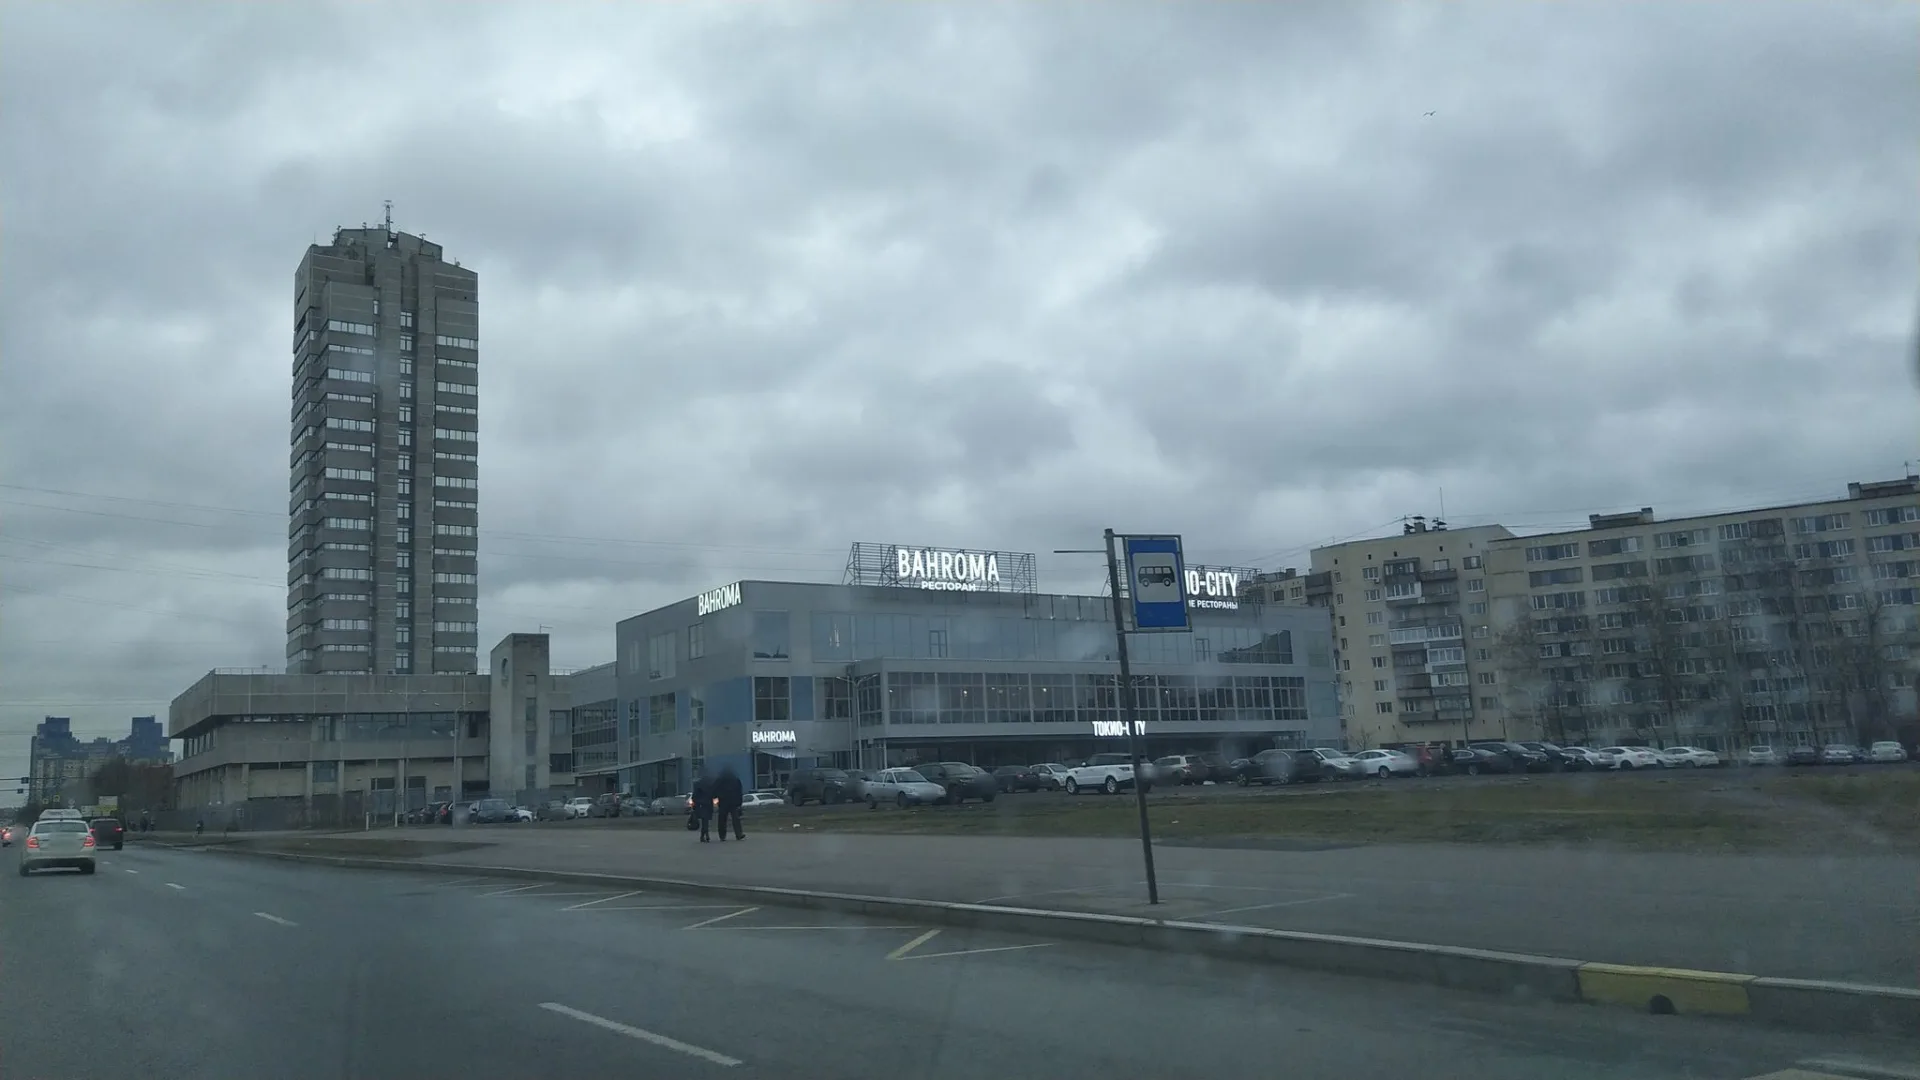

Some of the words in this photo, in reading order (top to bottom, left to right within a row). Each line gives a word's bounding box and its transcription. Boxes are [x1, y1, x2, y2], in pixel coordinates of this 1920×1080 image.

[897, 549, 1000, 582] BAHROMA
[921, 581, 976, 592] РЕСТОРАН
[698, 582, 742, 616] BAHROMA
[1197, 600, 1239, 610] РЕСТОРАНЫ
[752, 731, 797, 743] BAHROMA
